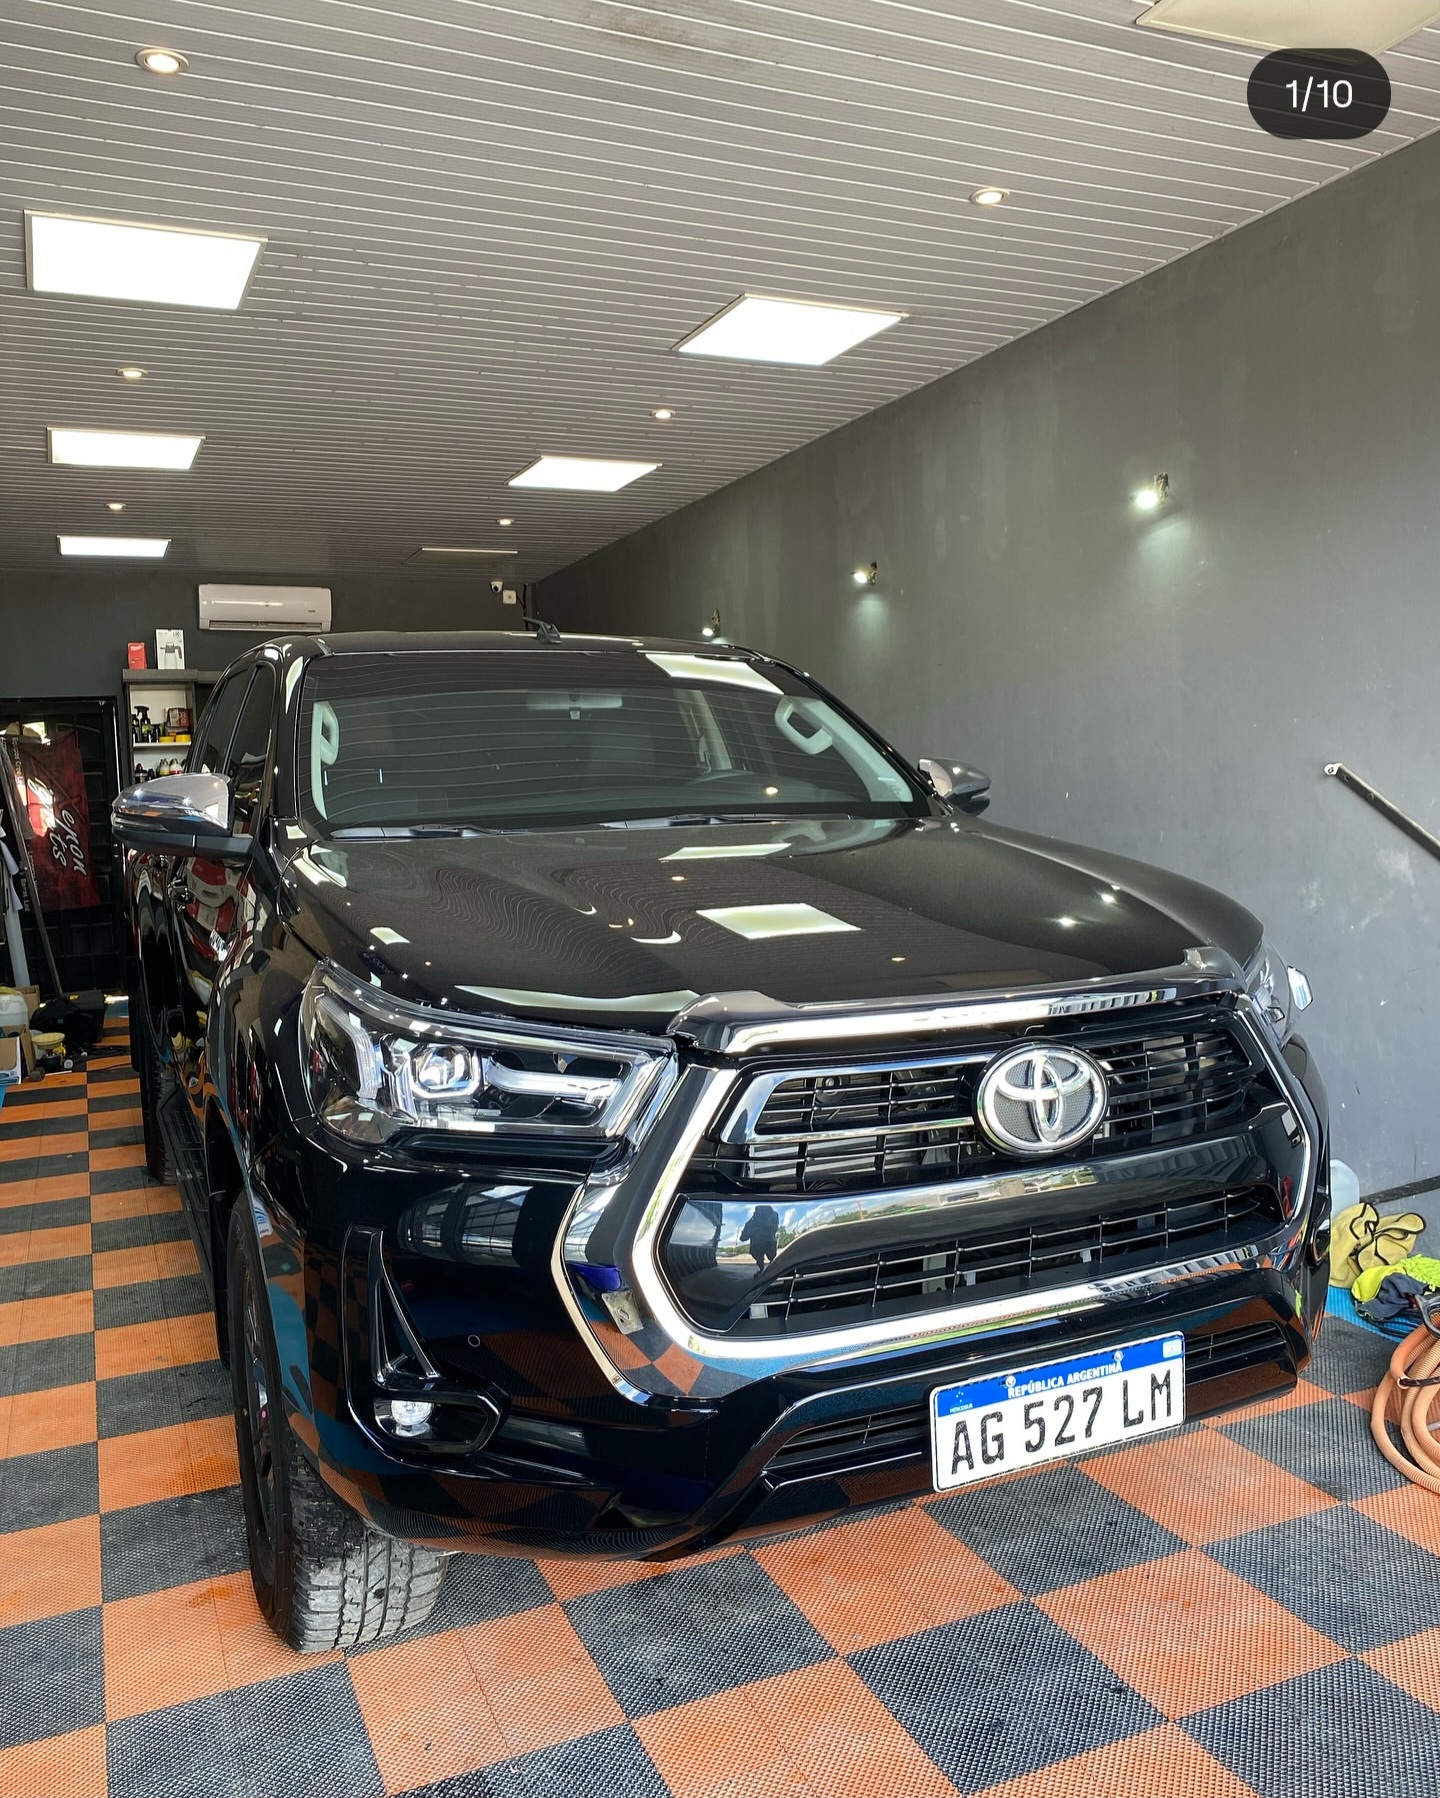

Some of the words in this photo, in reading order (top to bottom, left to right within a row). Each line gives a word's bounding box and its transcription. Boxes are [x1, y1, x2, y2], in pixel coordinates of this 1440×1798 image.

[1008, 1377, 1065, 1399] REPÚBLICA
[1067, 1361, 1123, 1389] ARGENTINA
[951, 1412, 1005, 1475] AG
[1024, 1386, 1103, 1453] 527
[1123, 1369, 1171, 1428] LM
